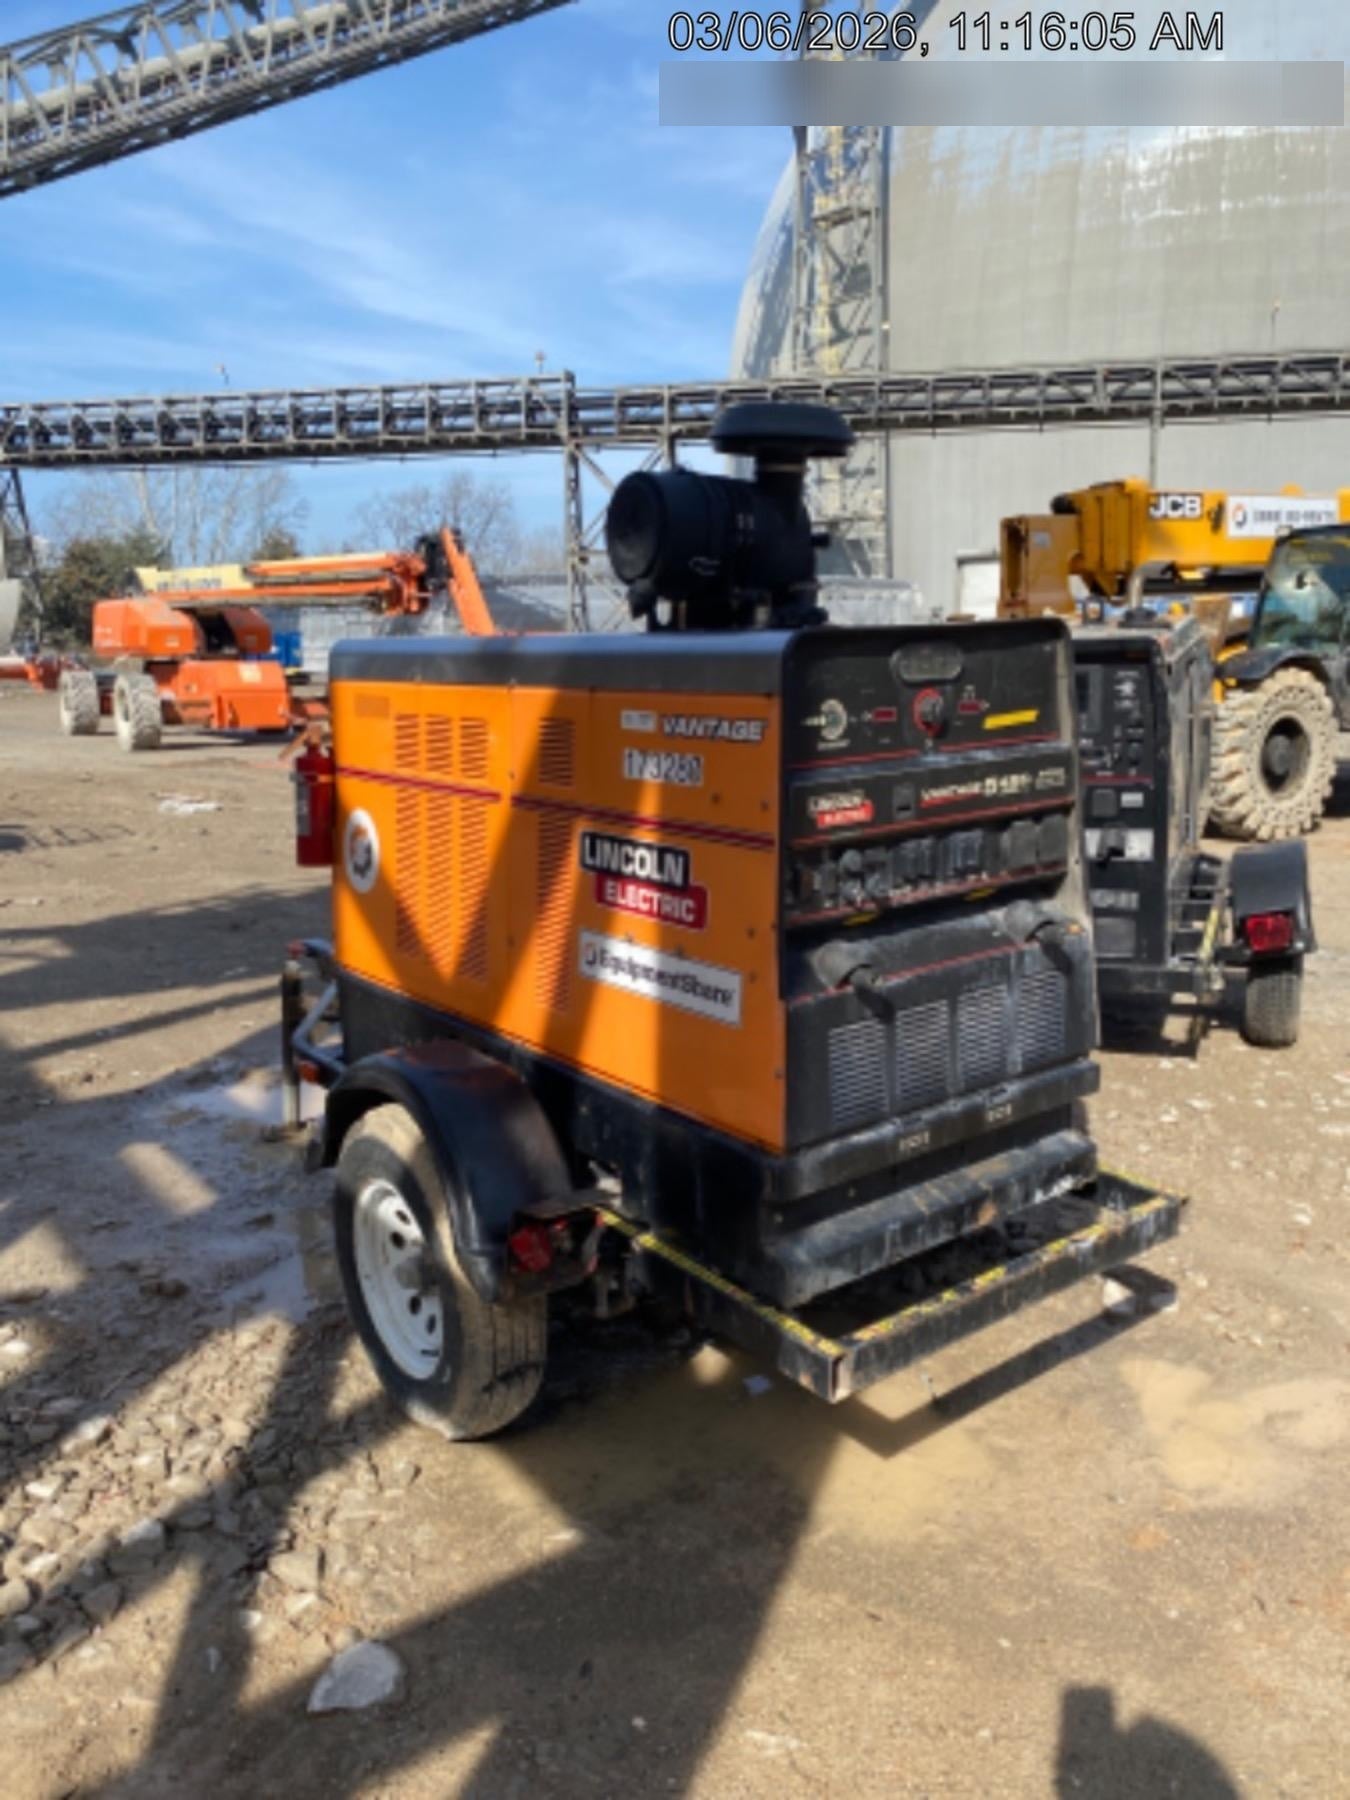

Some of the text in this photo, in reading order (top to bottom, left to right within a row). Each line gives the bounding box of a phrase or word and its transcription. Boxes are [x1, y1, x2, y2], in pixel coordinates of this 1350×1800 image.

[1151, 494, 1202, 519] JCB
[662, 715, 764, 741] VANTAGE
[584, 835, 685, 888] LINCOLN
[605, 879, 696, 923] ELECTRIC
